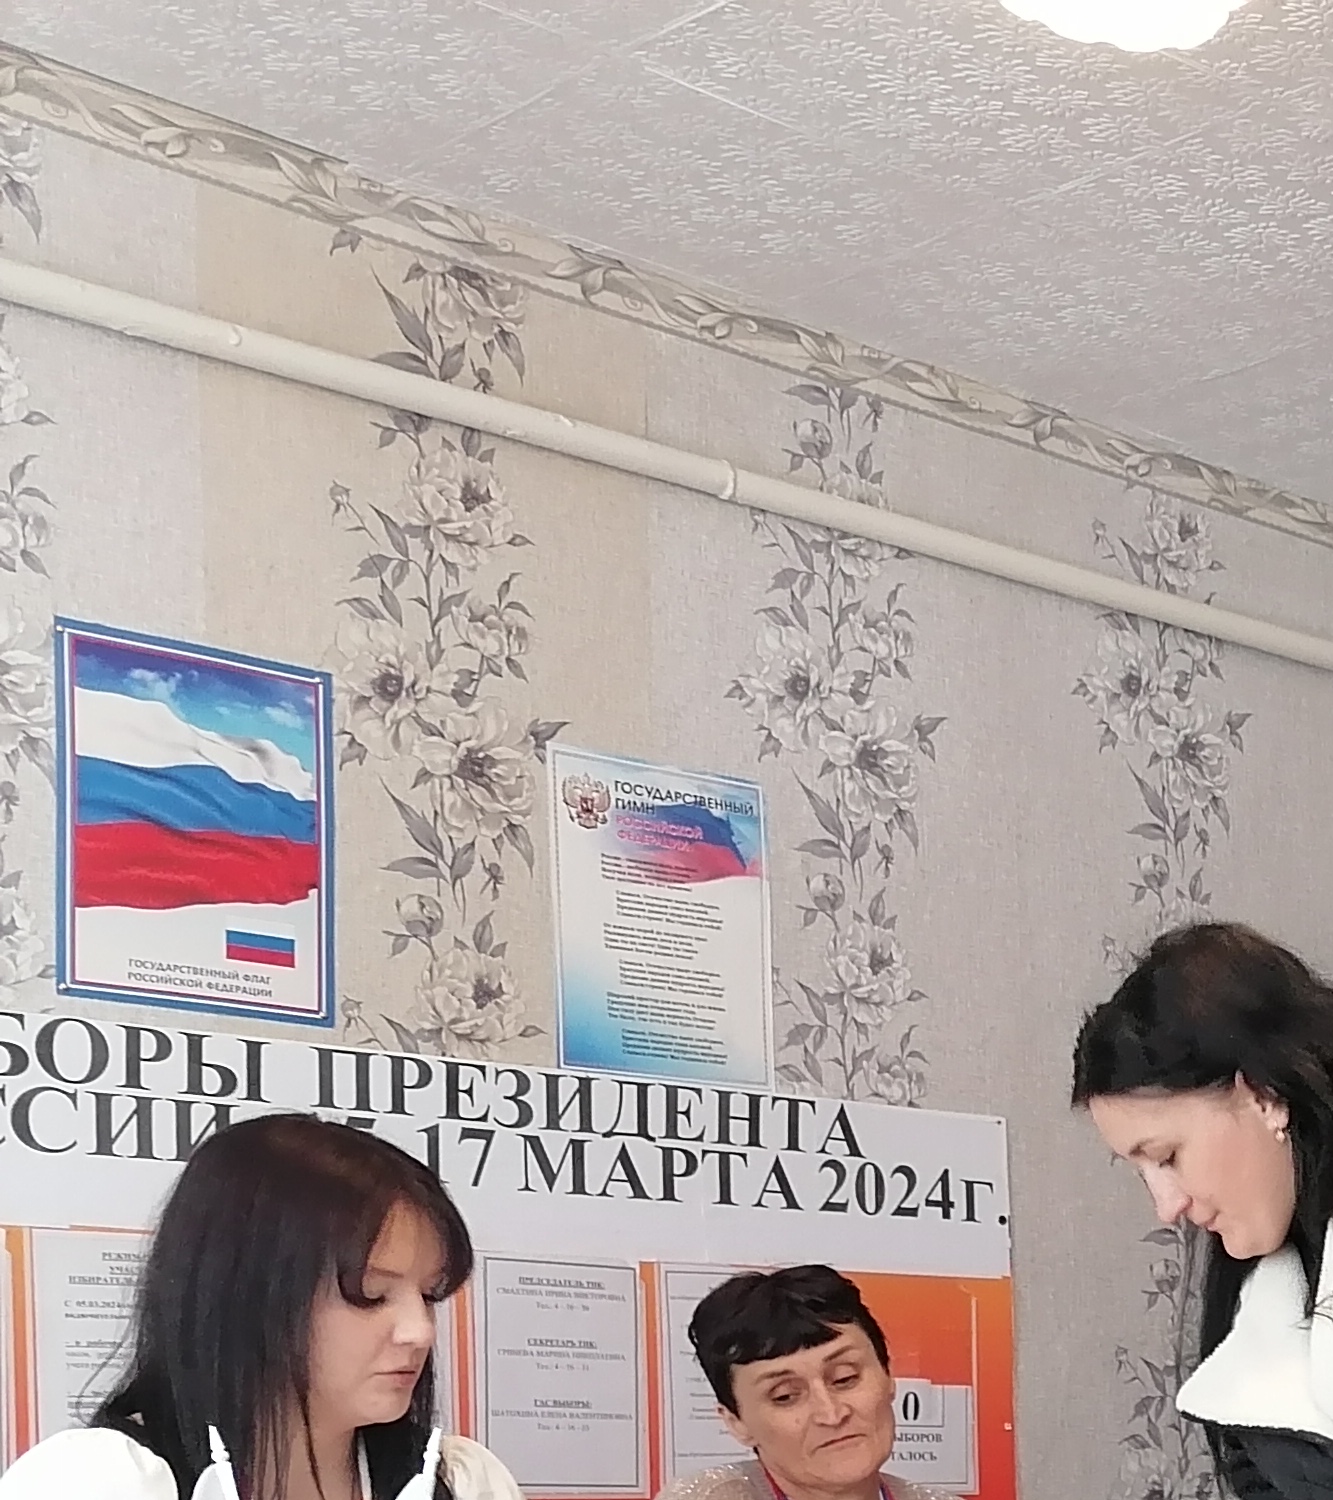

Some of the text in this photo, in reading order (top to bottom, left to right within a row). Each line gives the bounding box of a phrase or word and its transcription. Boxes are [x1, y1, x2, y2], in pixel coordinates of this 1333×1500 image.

[614, 780, 755, 817] ГОСУДАРСТВЕННЫЙ
[615, 797, 656, 815] ГИМН
[616, 814, 704, 840] РОССИЙСКОЙ
[127, 972, 273, 998] РОССИЙСКОЙ ФЕДЕРАЦИИ
[128, 958, 272, 985] ГОСУДАРСТВЕННЫЙ ФЛАГ
[310, 1045, 867, 1159] ПРЕЗИДЕНТА
[0, 1083, 243, 1162] СИИ
[516, 1133, 805, 1211] МАРТА
